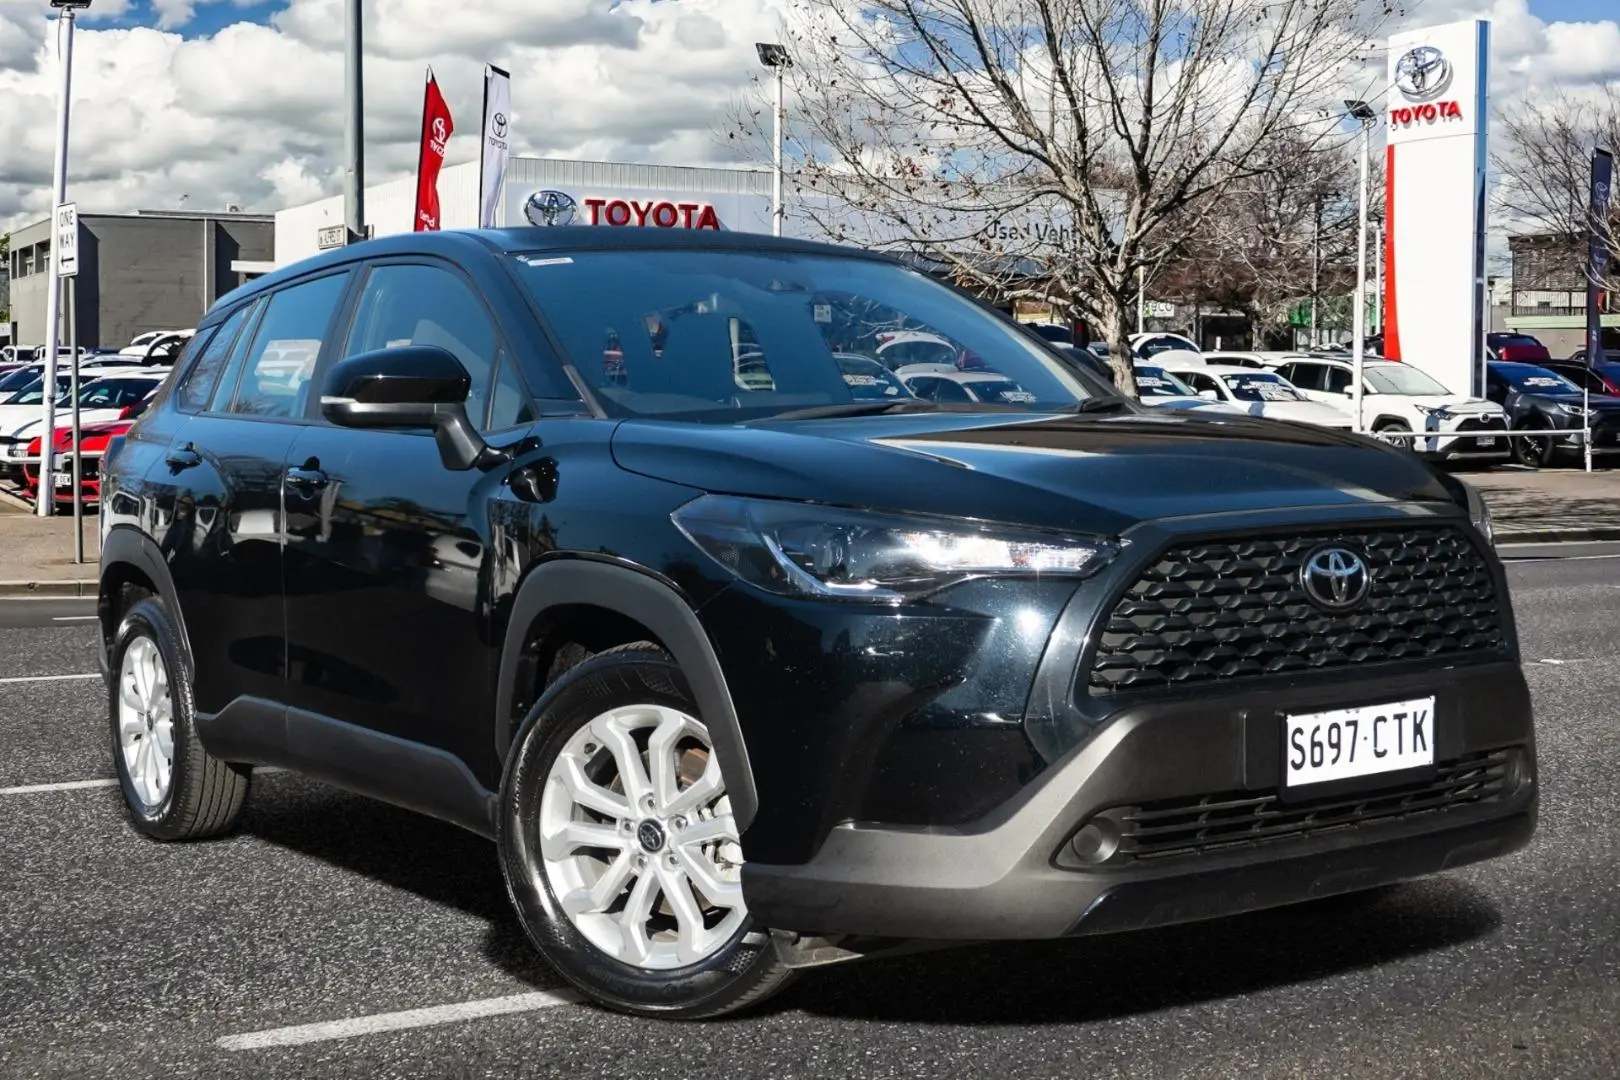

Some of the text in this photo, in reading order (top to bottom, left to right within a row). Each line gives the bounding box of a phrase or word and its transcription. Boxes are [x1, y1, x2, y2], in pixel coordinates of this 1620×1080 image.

[1389, 101, 1461, 124] TOYOTA
[60, 210, 74, 227] ONE
[584, 199, 720, 231] TOYOTA
[59, 232, 75, 248] WAY
[985, 219, 1029, 240] Used
